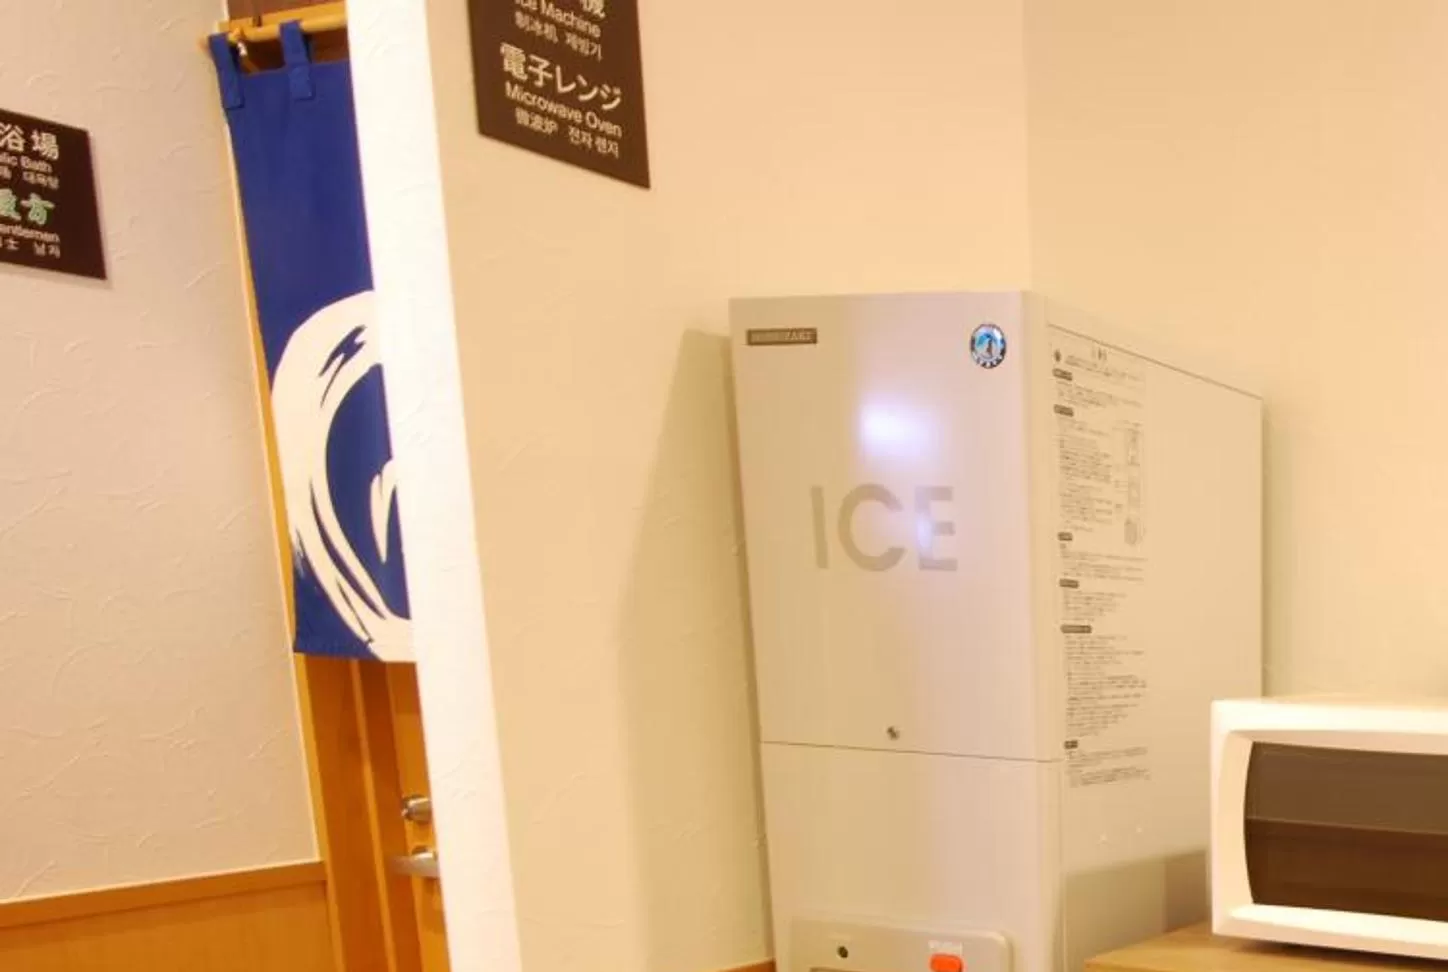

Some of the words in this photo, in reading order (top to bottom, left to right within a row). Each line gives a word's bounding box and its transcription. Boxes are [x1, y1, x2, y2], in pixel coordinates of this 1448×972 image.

[541, 0, 601, 38] Machine
[500, 41, 621, 111] 電子レンジ
[505, 80, 583, 124] Microwave
[585, 111, 622, 140] Oven
[811, 483, 958, 572] ICE
